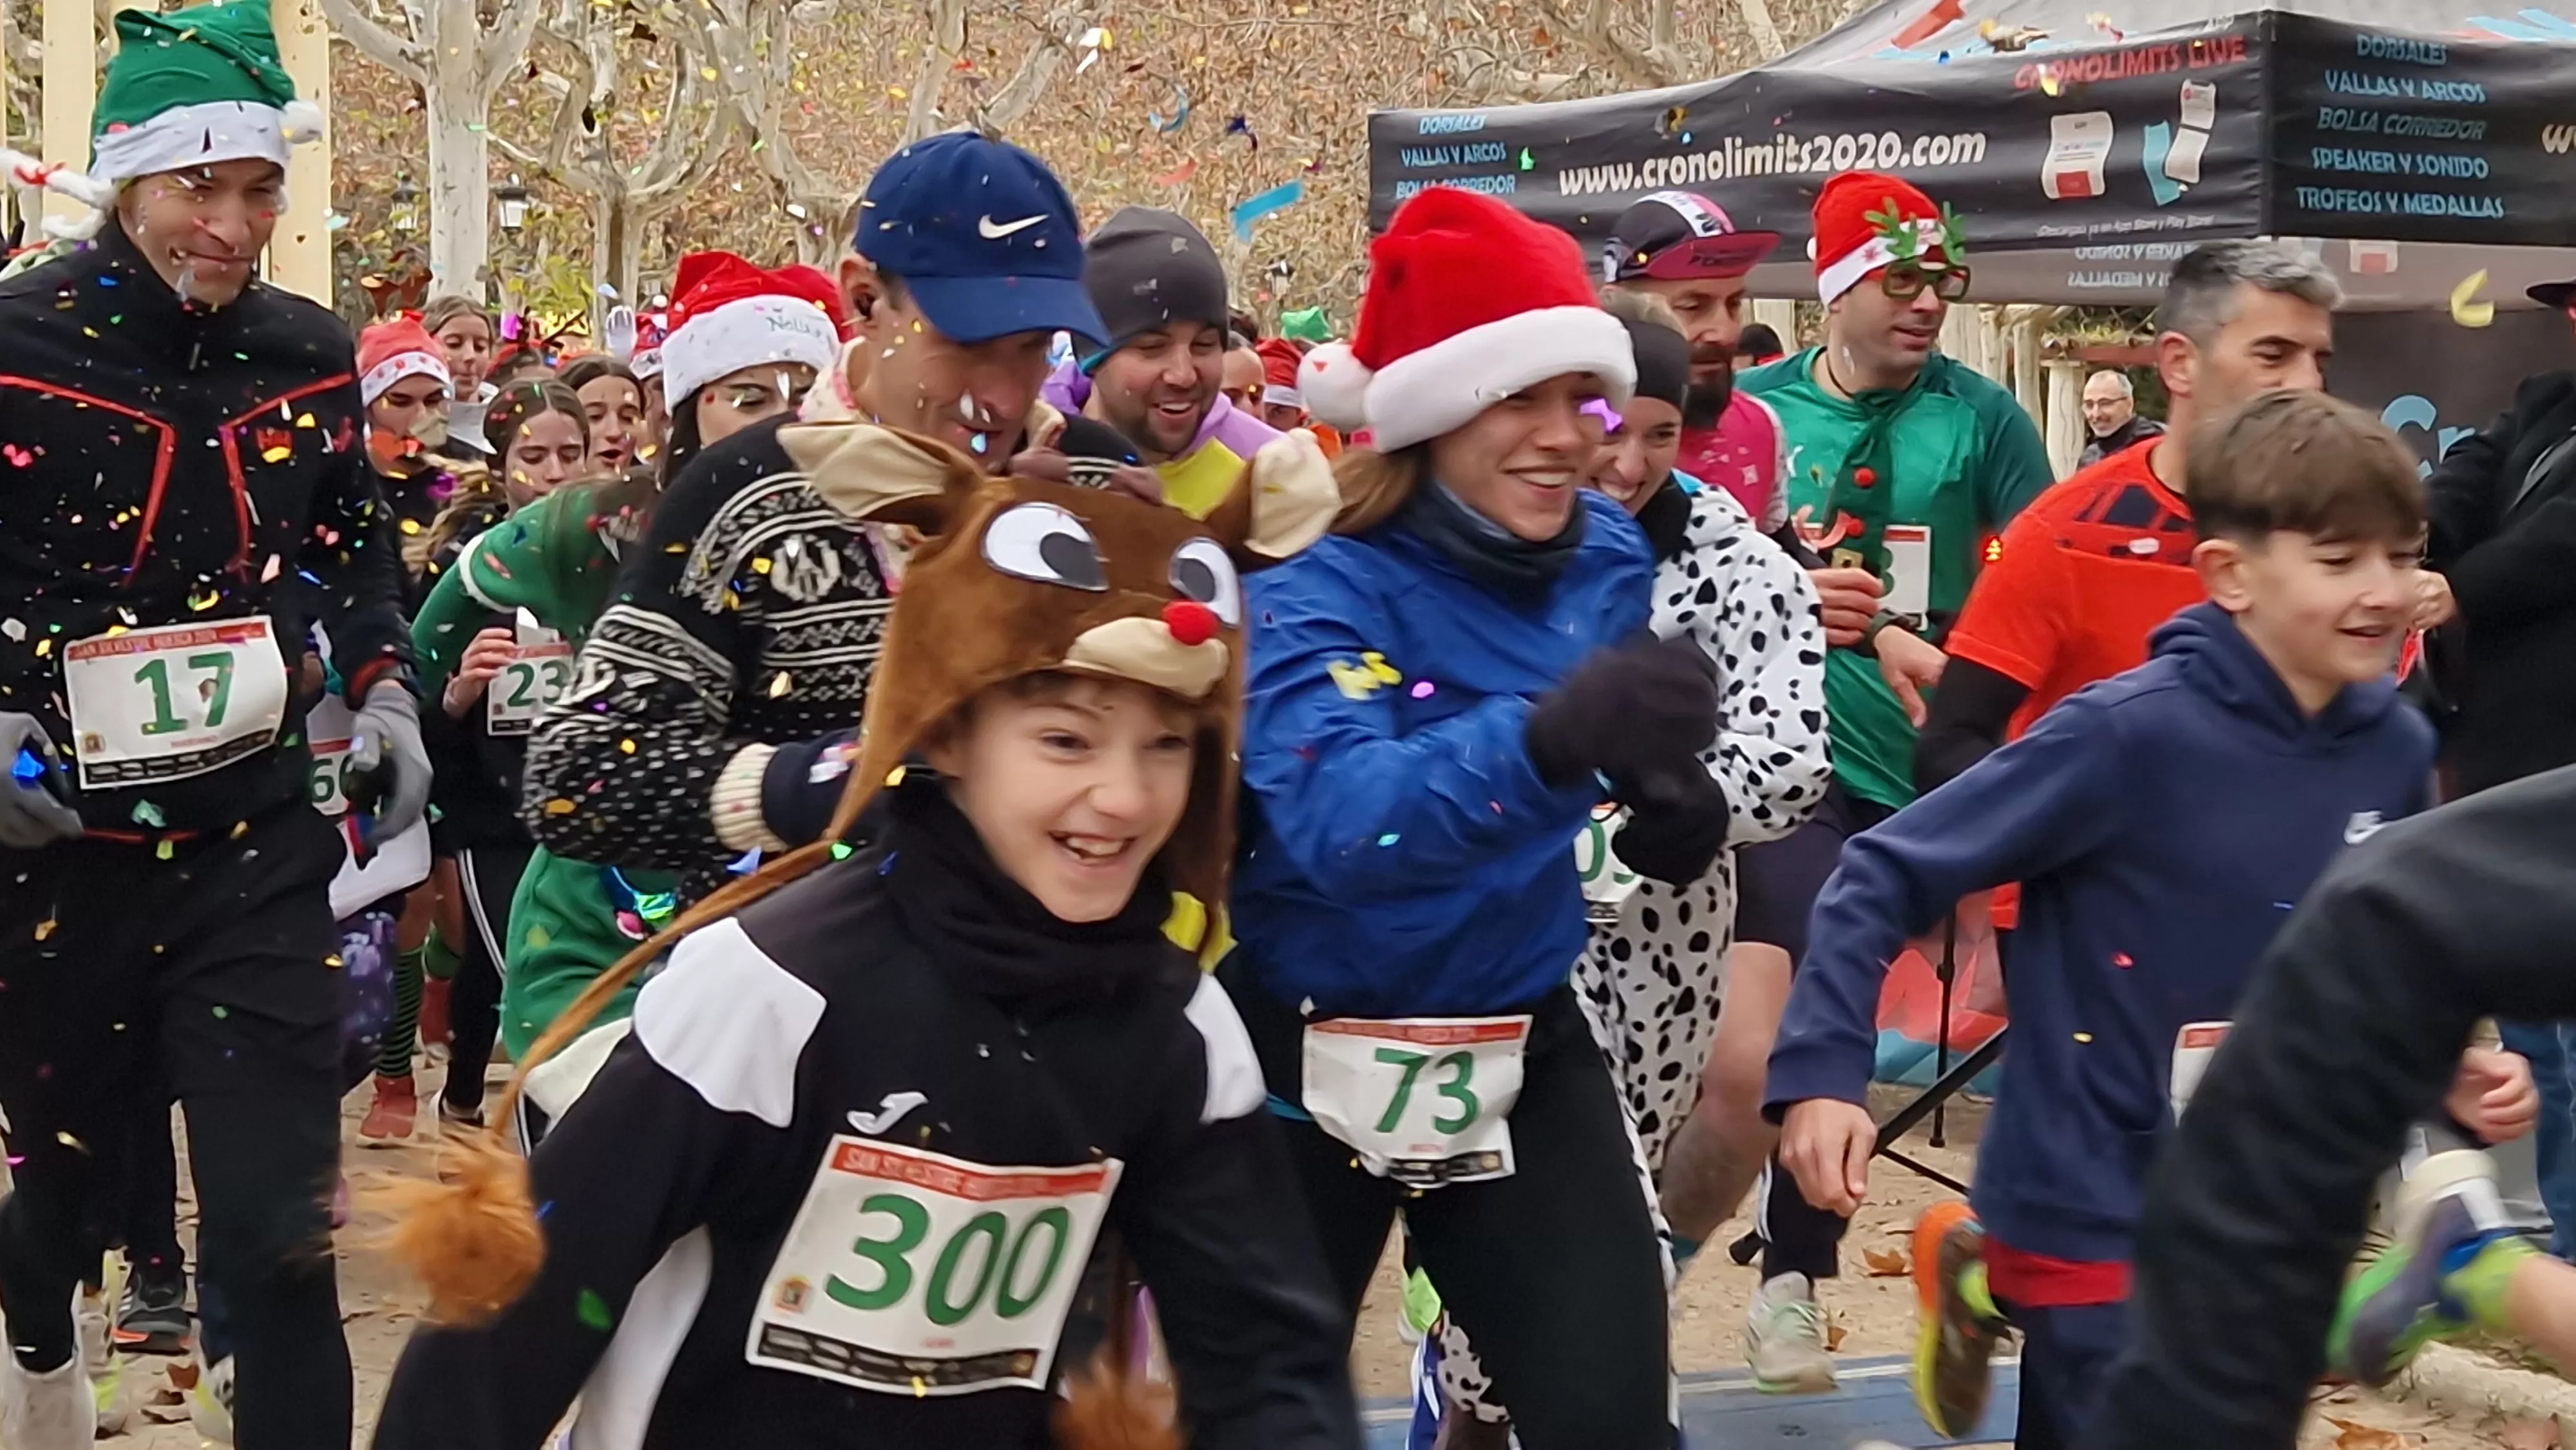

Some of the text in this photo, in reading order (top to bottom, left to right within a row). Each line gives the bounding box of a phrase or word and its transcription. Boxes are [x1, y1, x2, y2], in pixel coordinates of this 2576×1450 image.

[2356, 33, 2447, 65] DORSALES
[2325, 69, 2486, 103] VALLAS Y ARCOS
[2317, 106, 2488, 140] BOLSA CORREDOR
[1401, 142, 1507, 167] VALLAS Y ARCOS
[1559, 131, 1986, 196] www.cronolimits2020.com
[2311, 147, 2489, 180] SPEAKER Y SONIDO
[2296, 186, 2505, 219] TROFEOS Y MEDALLAS
[135, 650, 234, 735] 17
[507, 659, 571, 707] 23
[1373, 1048, 1478, 1135] 73
[825, 1193, 1069, 1326] 300
